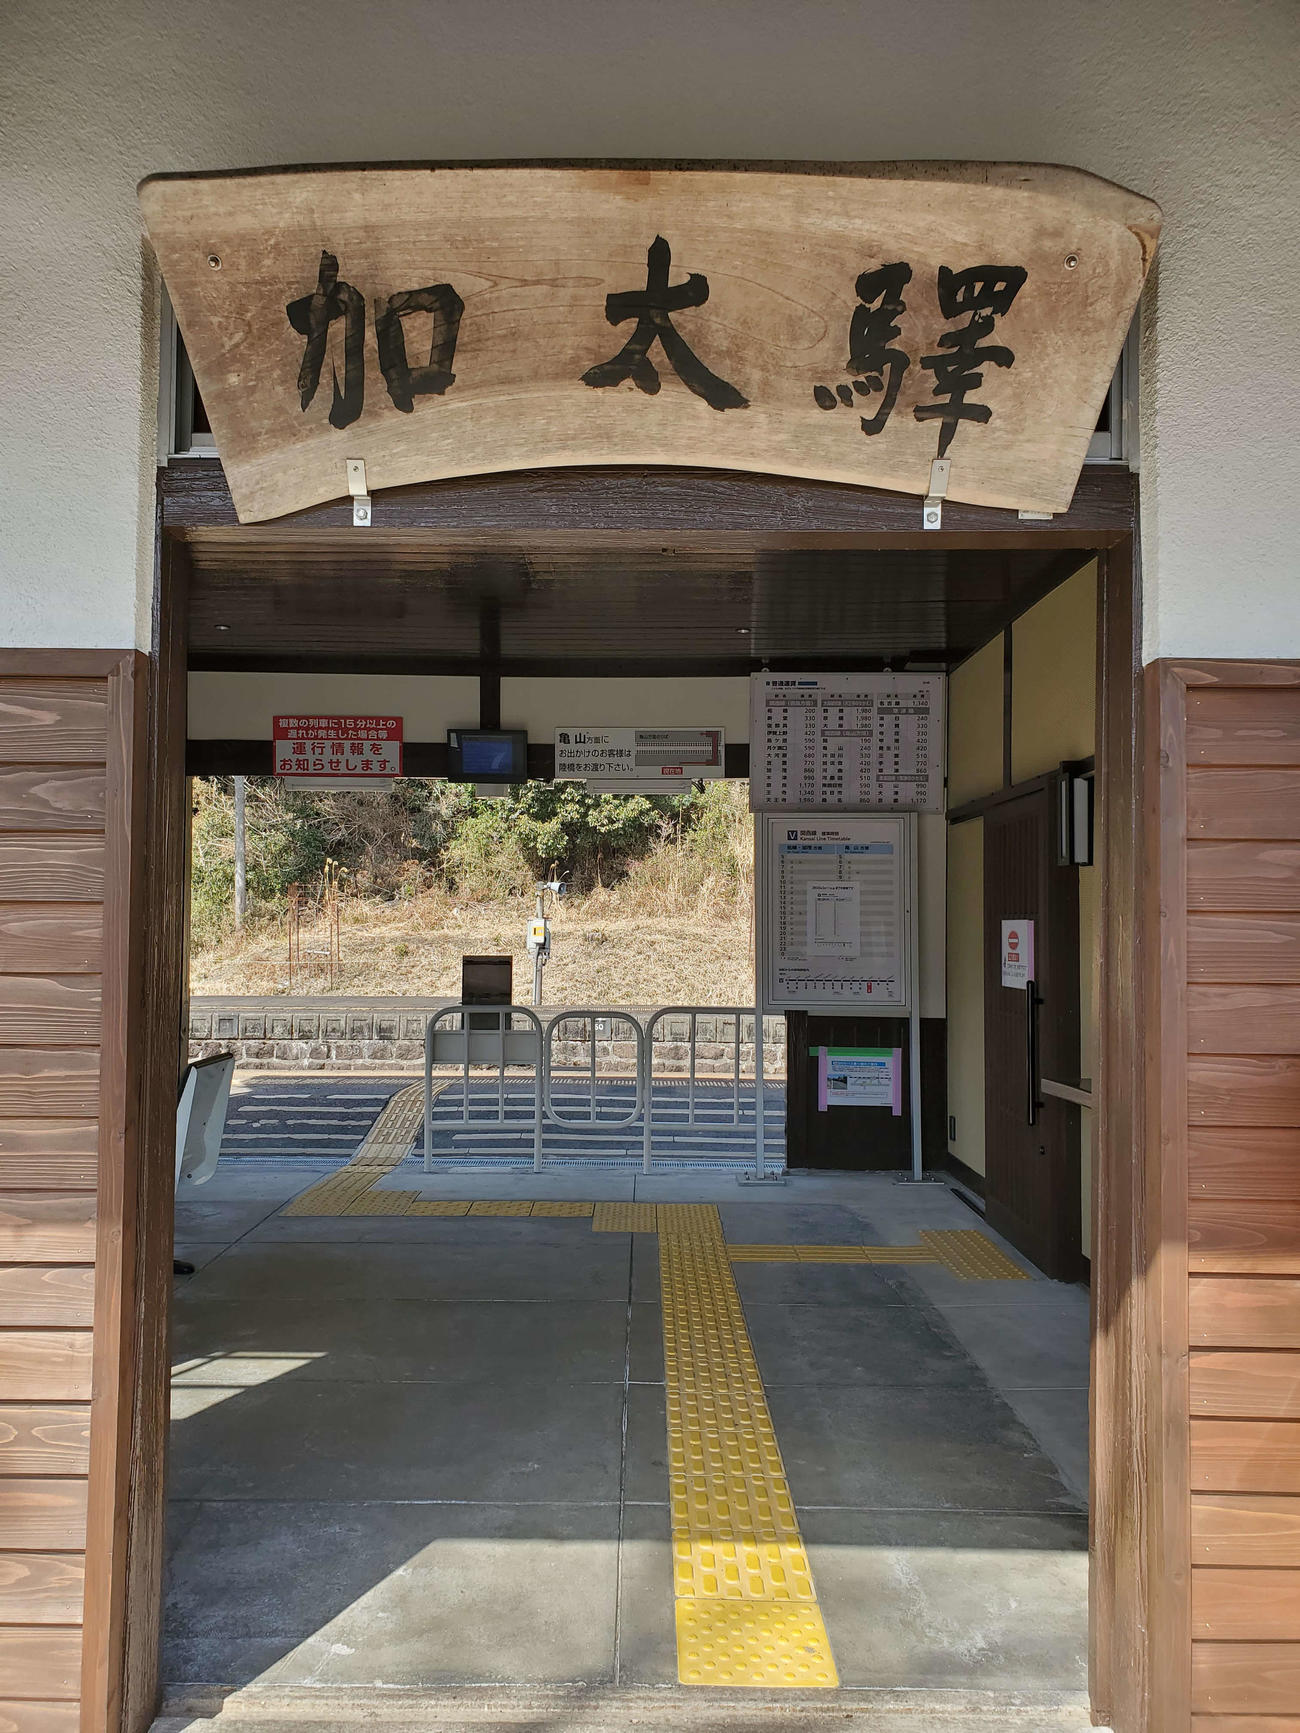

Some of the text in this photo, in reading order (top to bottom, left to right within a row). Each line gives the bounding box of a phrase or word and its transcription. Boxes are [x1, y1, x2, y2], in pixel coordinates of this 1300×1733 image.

[279, 718, 396, 728] 複数の列車に15分以上の
[292, 742, 382, 756] 運行情報を
[559, 749, 631, 758] お出かけのお客様は
[280, 758, 396, 772] お知らせします。
[559, 763, 634, 772] 陸橋をお渡り下さい。
